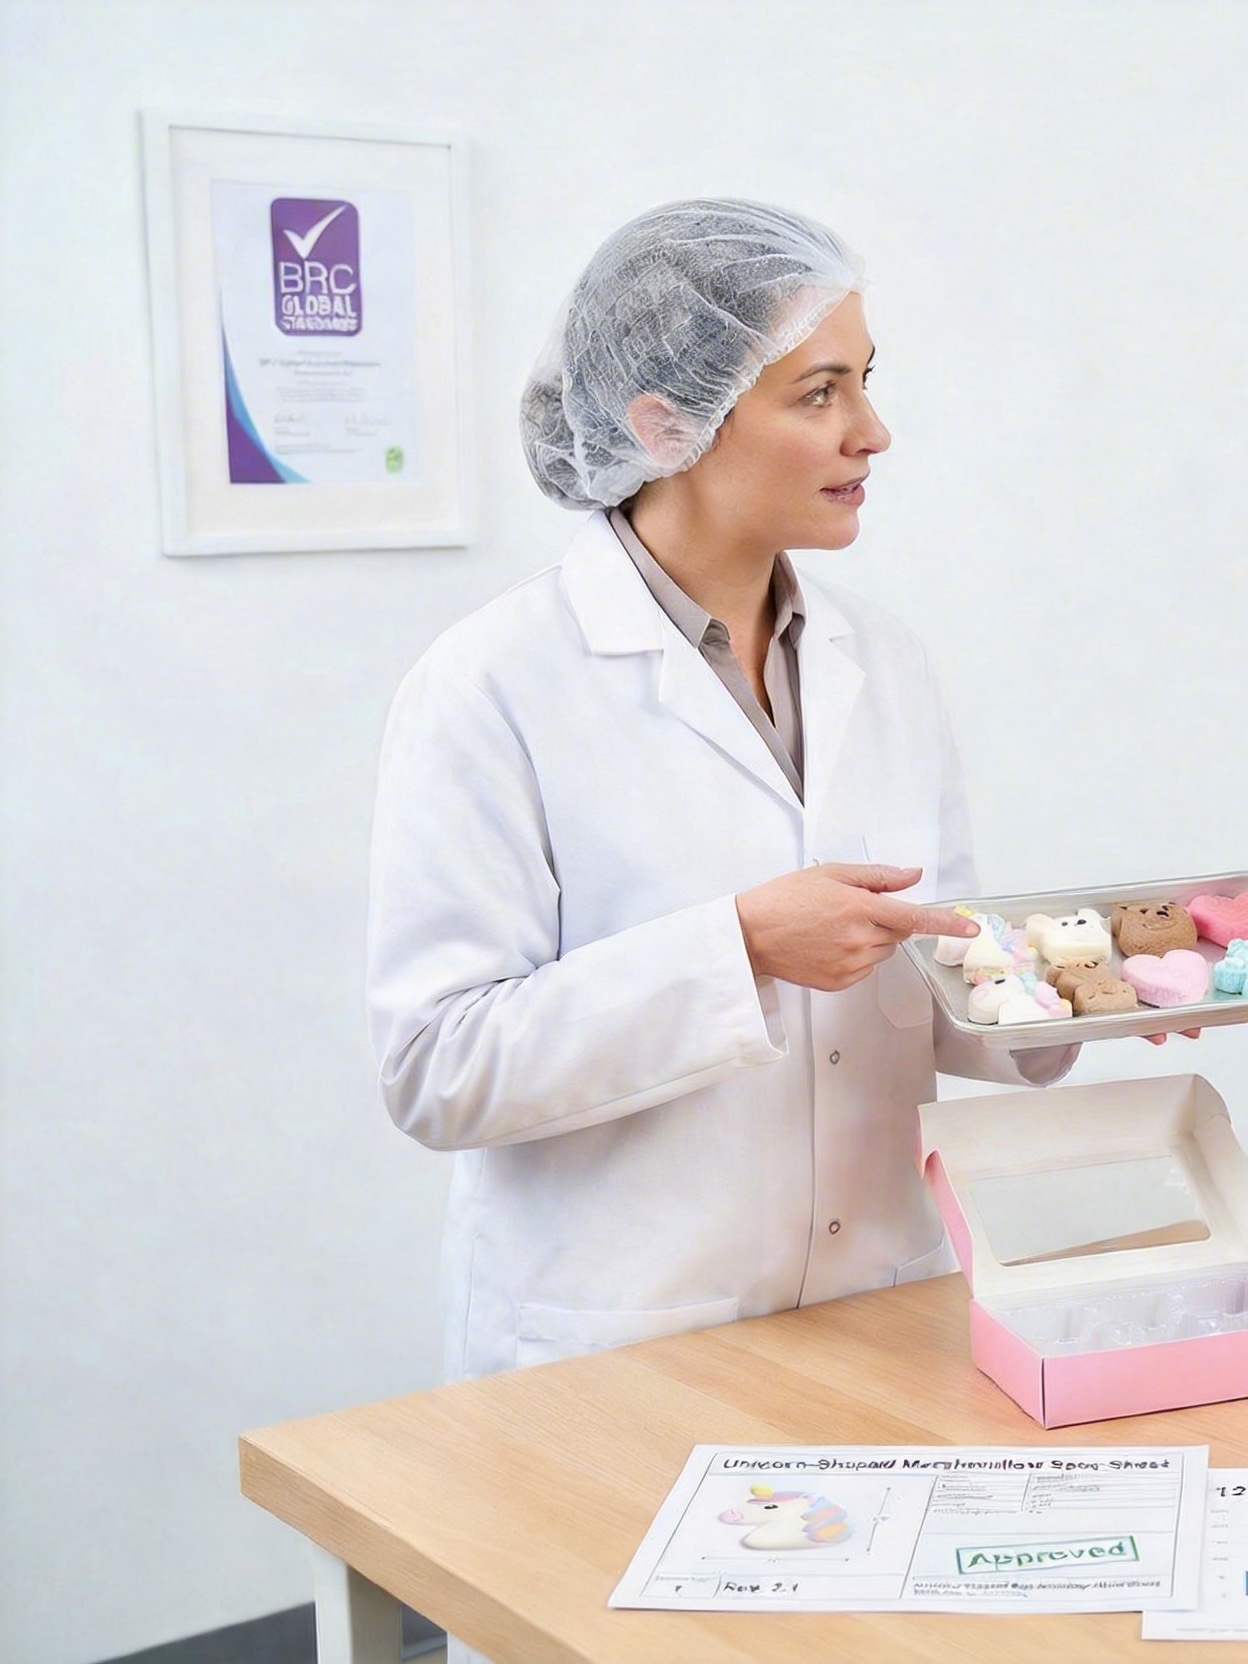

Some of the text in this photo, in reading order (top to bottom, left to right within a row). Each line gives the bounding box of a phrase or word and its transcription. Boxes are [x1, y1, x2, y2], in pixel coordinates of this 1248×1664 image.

[279, 260, 357, 295] BRC
[282, 294, 357, 317] GLOBAL
[967, 1541, 1126, 1571] Approved
